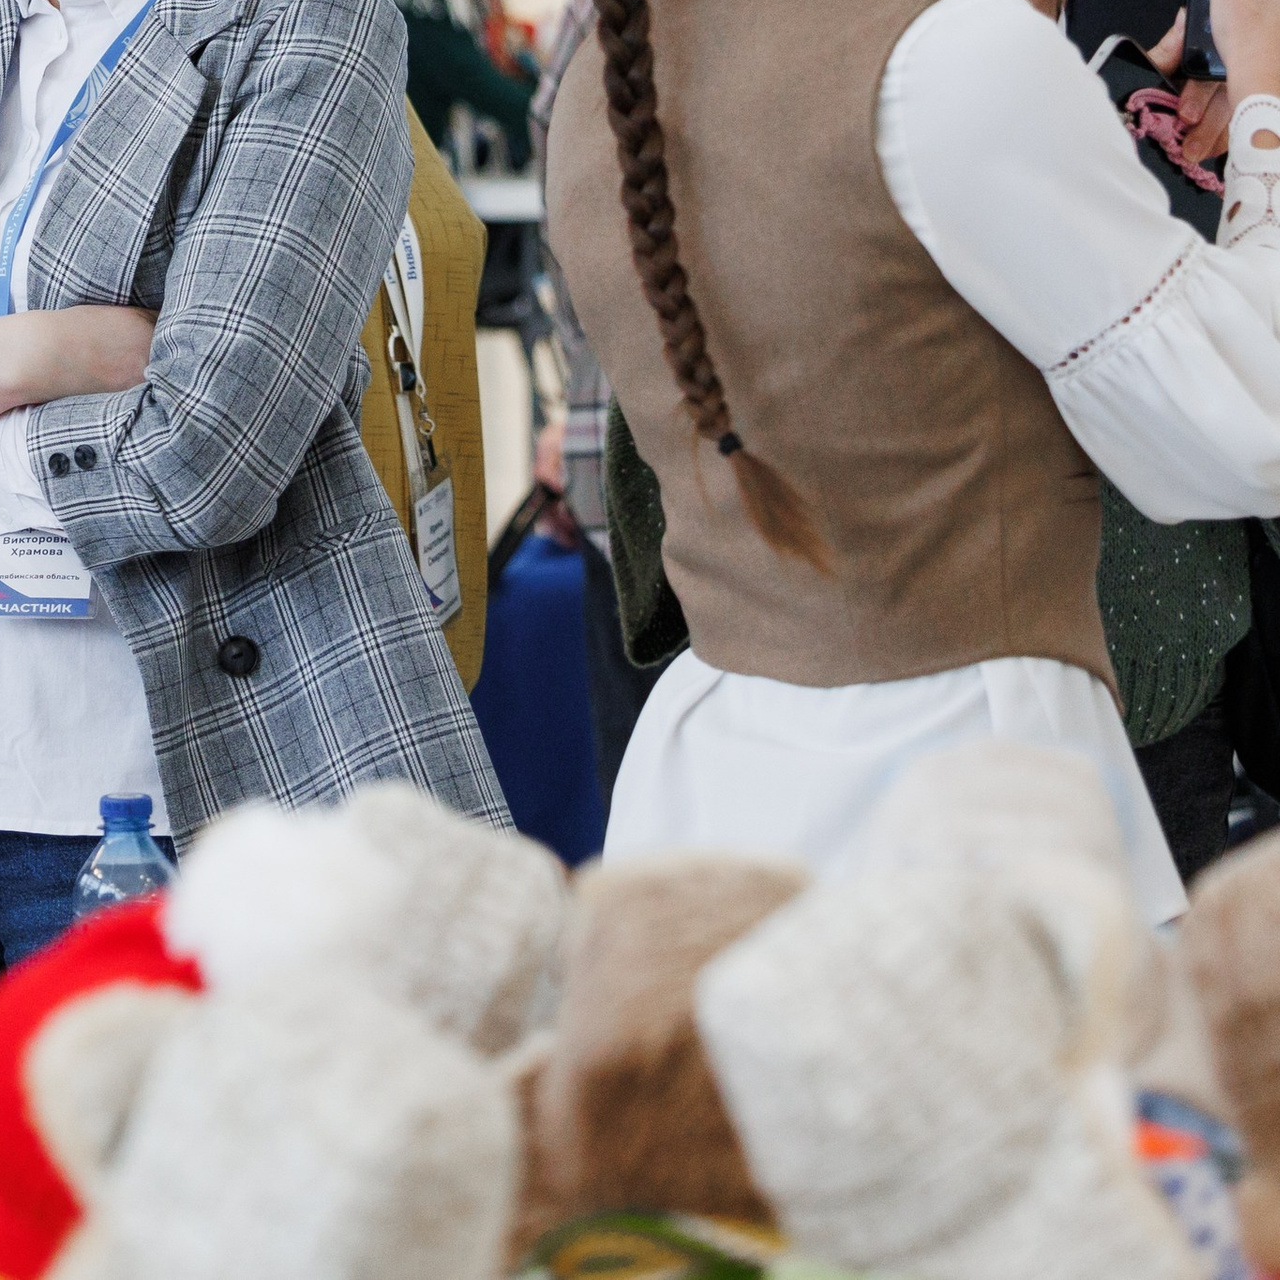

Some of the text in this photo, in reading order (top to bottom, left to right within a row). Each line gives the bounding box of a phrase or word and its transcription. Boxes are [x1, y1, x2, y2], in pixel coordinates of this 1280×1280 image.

[0, 222, 17, 277] Виват,
[401, 233, 418, 280] Виват,
[11, 548, 63, 557] Храмова
[46, 573, 80, 581] область
